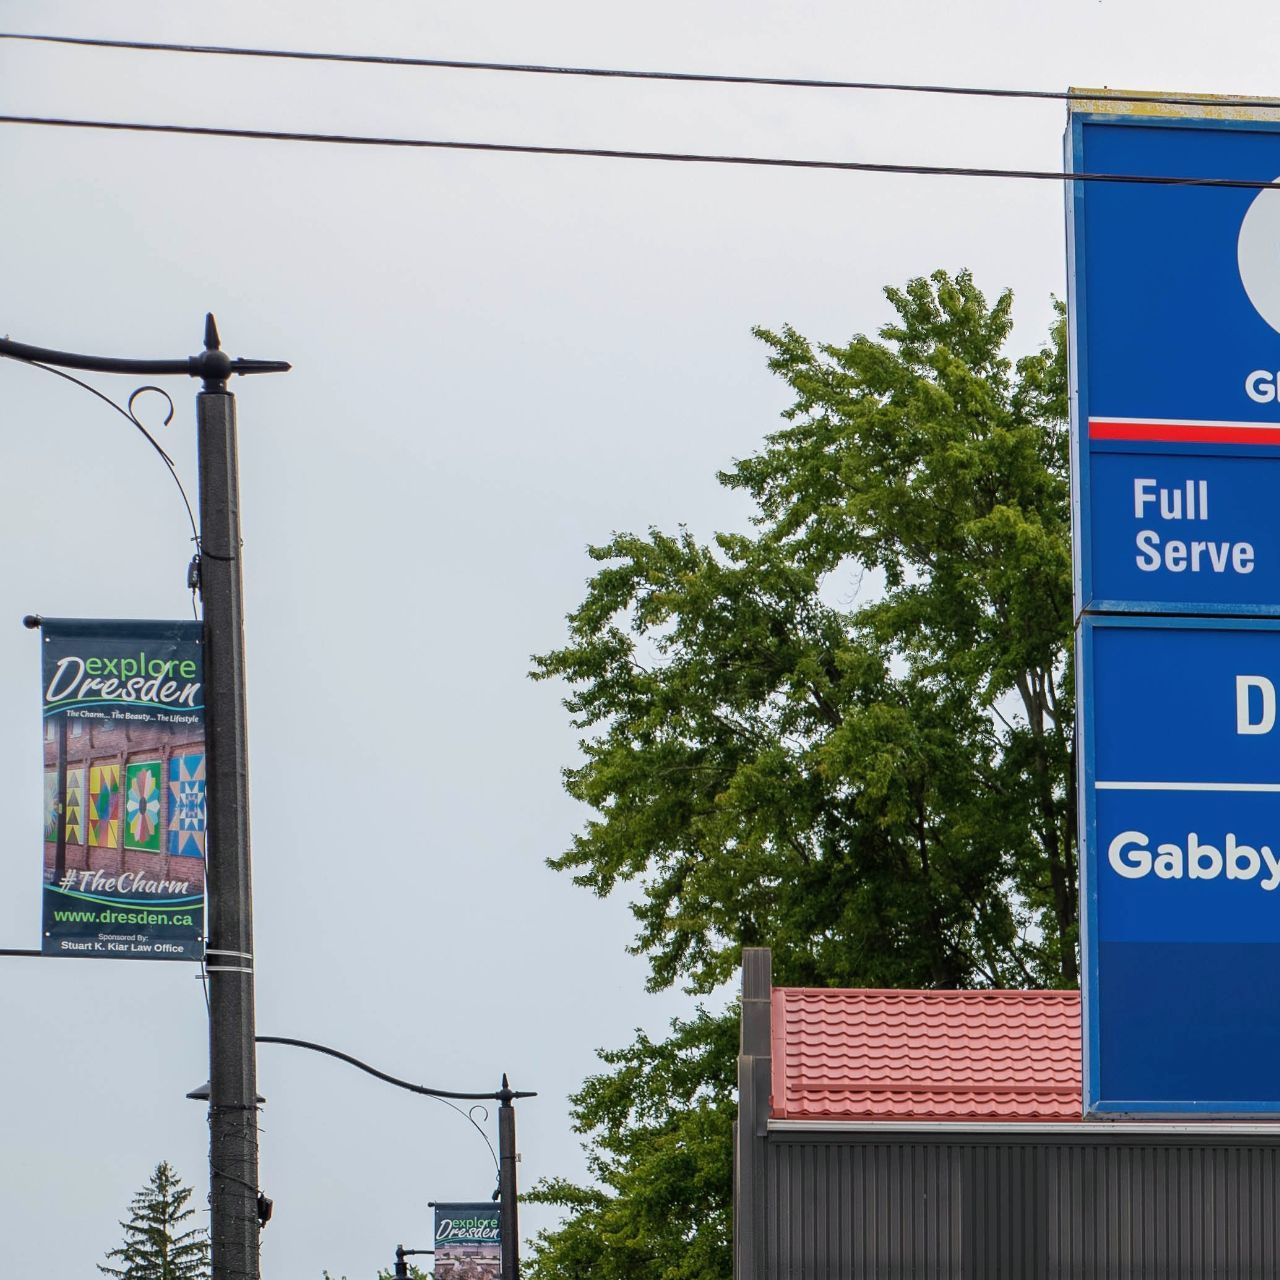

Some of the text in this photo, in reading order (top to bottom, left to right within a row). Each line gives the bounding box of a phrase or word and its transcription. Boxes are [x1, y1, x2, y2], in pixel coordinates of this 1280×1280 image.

[1133, 478, 1208, 520] Full
[1136, 530, 1255, 574] Serve
[85, 652, 196, 681] explore
[46, 656, 201, 706] Dresden
[66, 710, 80, 718] The
[111, 711, 124, 719] The
[170, 714, 199, 724] Lifestyle
[59, 869, 189, 894] #TheCharm
[54, 910, 193, 926] www.dresden.ca
[61, 941, 184, 953] Stuart K. Kiar Law Office
[98, 933, 149, 943] Sponsored By:
[436, 1219, 500, 1239] Dresden
[452, 1216, 498, 1229] explore
